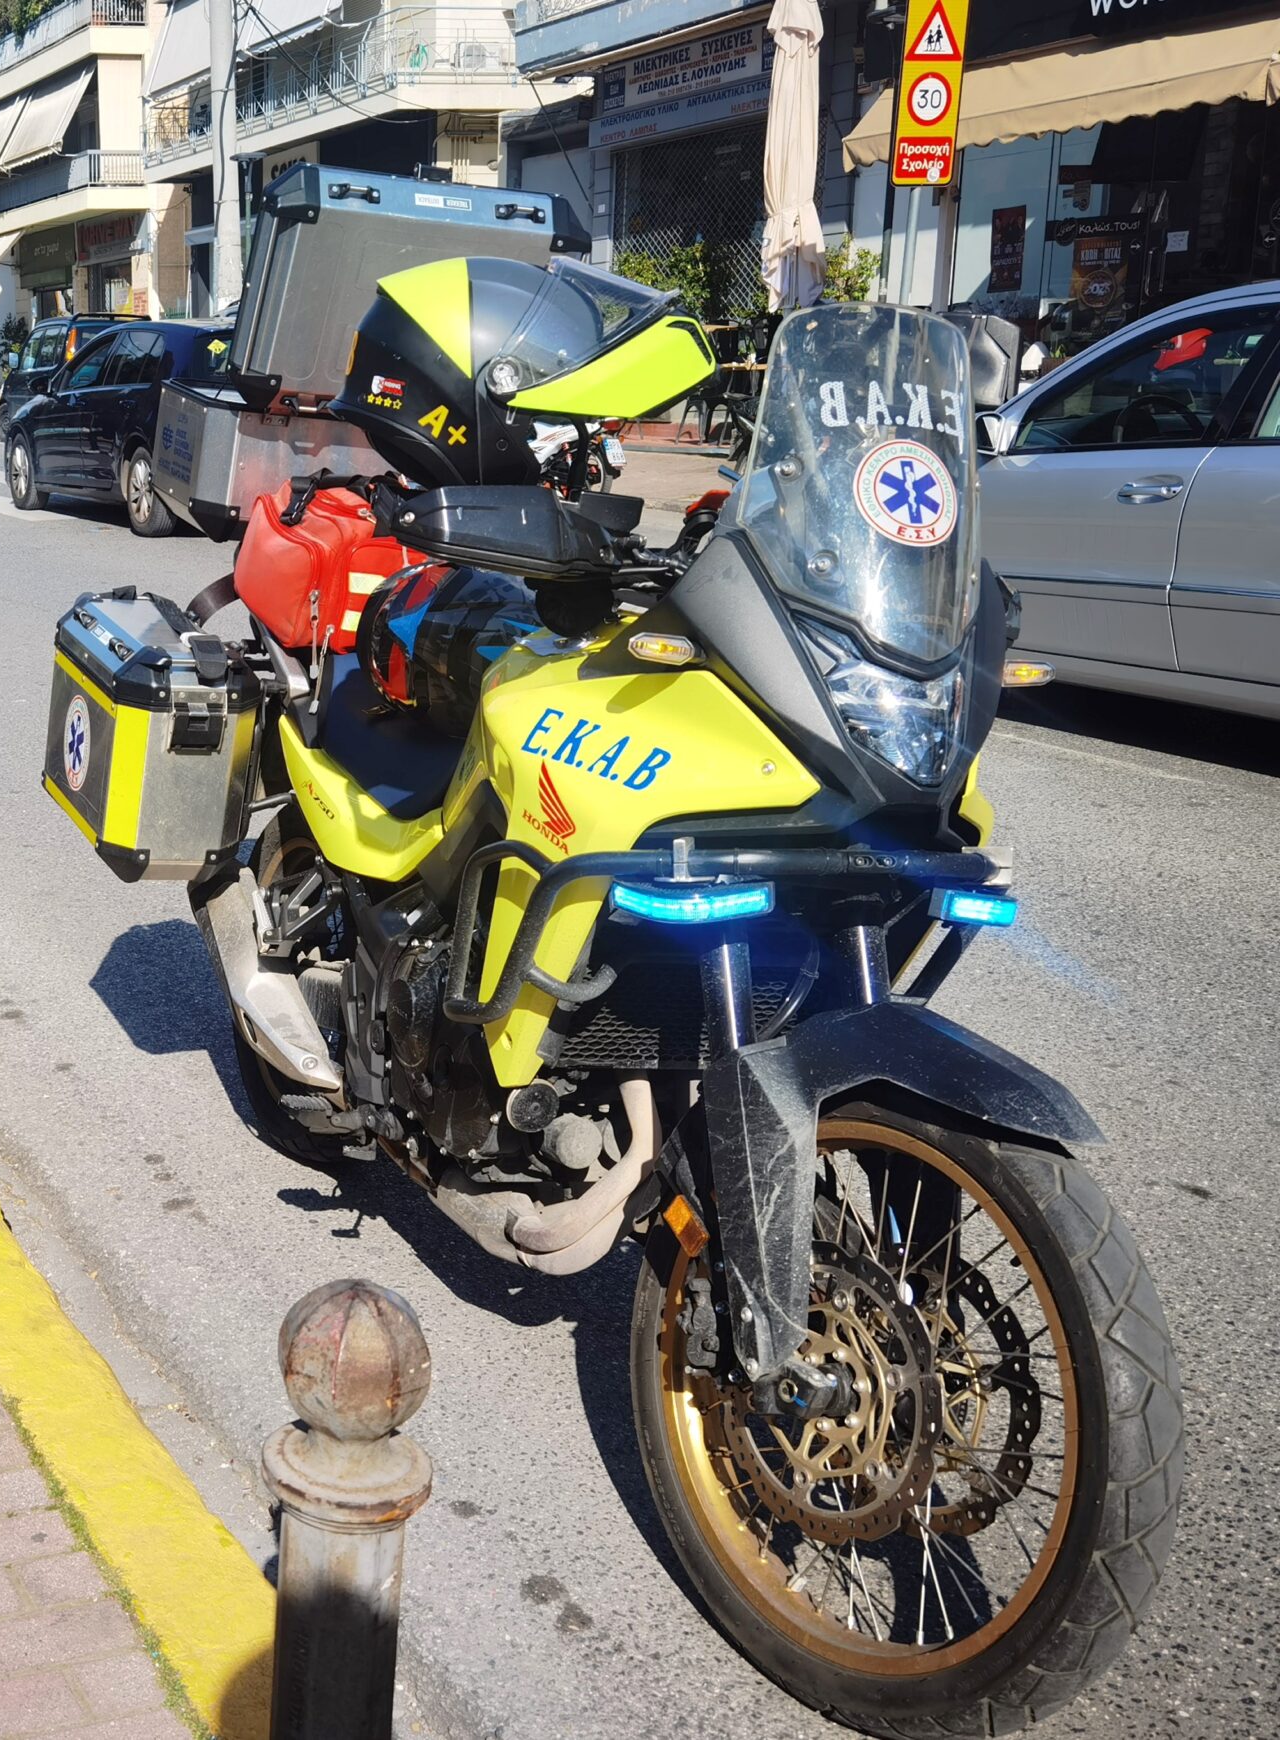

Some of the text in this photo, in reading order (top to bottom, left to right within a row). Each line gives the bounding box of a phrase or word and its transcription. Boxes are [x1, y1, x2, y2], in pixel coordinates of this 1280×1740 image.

[633, 47, 690, 76] ΗΛΕΚΤΡΙΚΕΣ
[701, 29, 753, 57] ΣΥΣΚΕΥΕΣ
[637, 74, 680, 95] ΛΕΩΝΙΔΑΣ
[917, 89, 942, 109] 30
[600, 108, 656, 128] ΗΛΕΚΤΡΟΛΟΓΙΚΟ
[657, 102, 680, 115] ΥΛΙΚΟ
[686, 85, 745, 107] ΑΝΤΑΛΛΑΚΤΙΚΑ
[899, 142, 950, 156] Προσοχή
[901, 157, 944, 172] Σχολείο
[867, 446, 898, 476] ΚΕΝΤΡΟ
[863, 479, 881, 518] ΕΘΝΙΚΟ
[522, 808, 569, 855] HONDA
